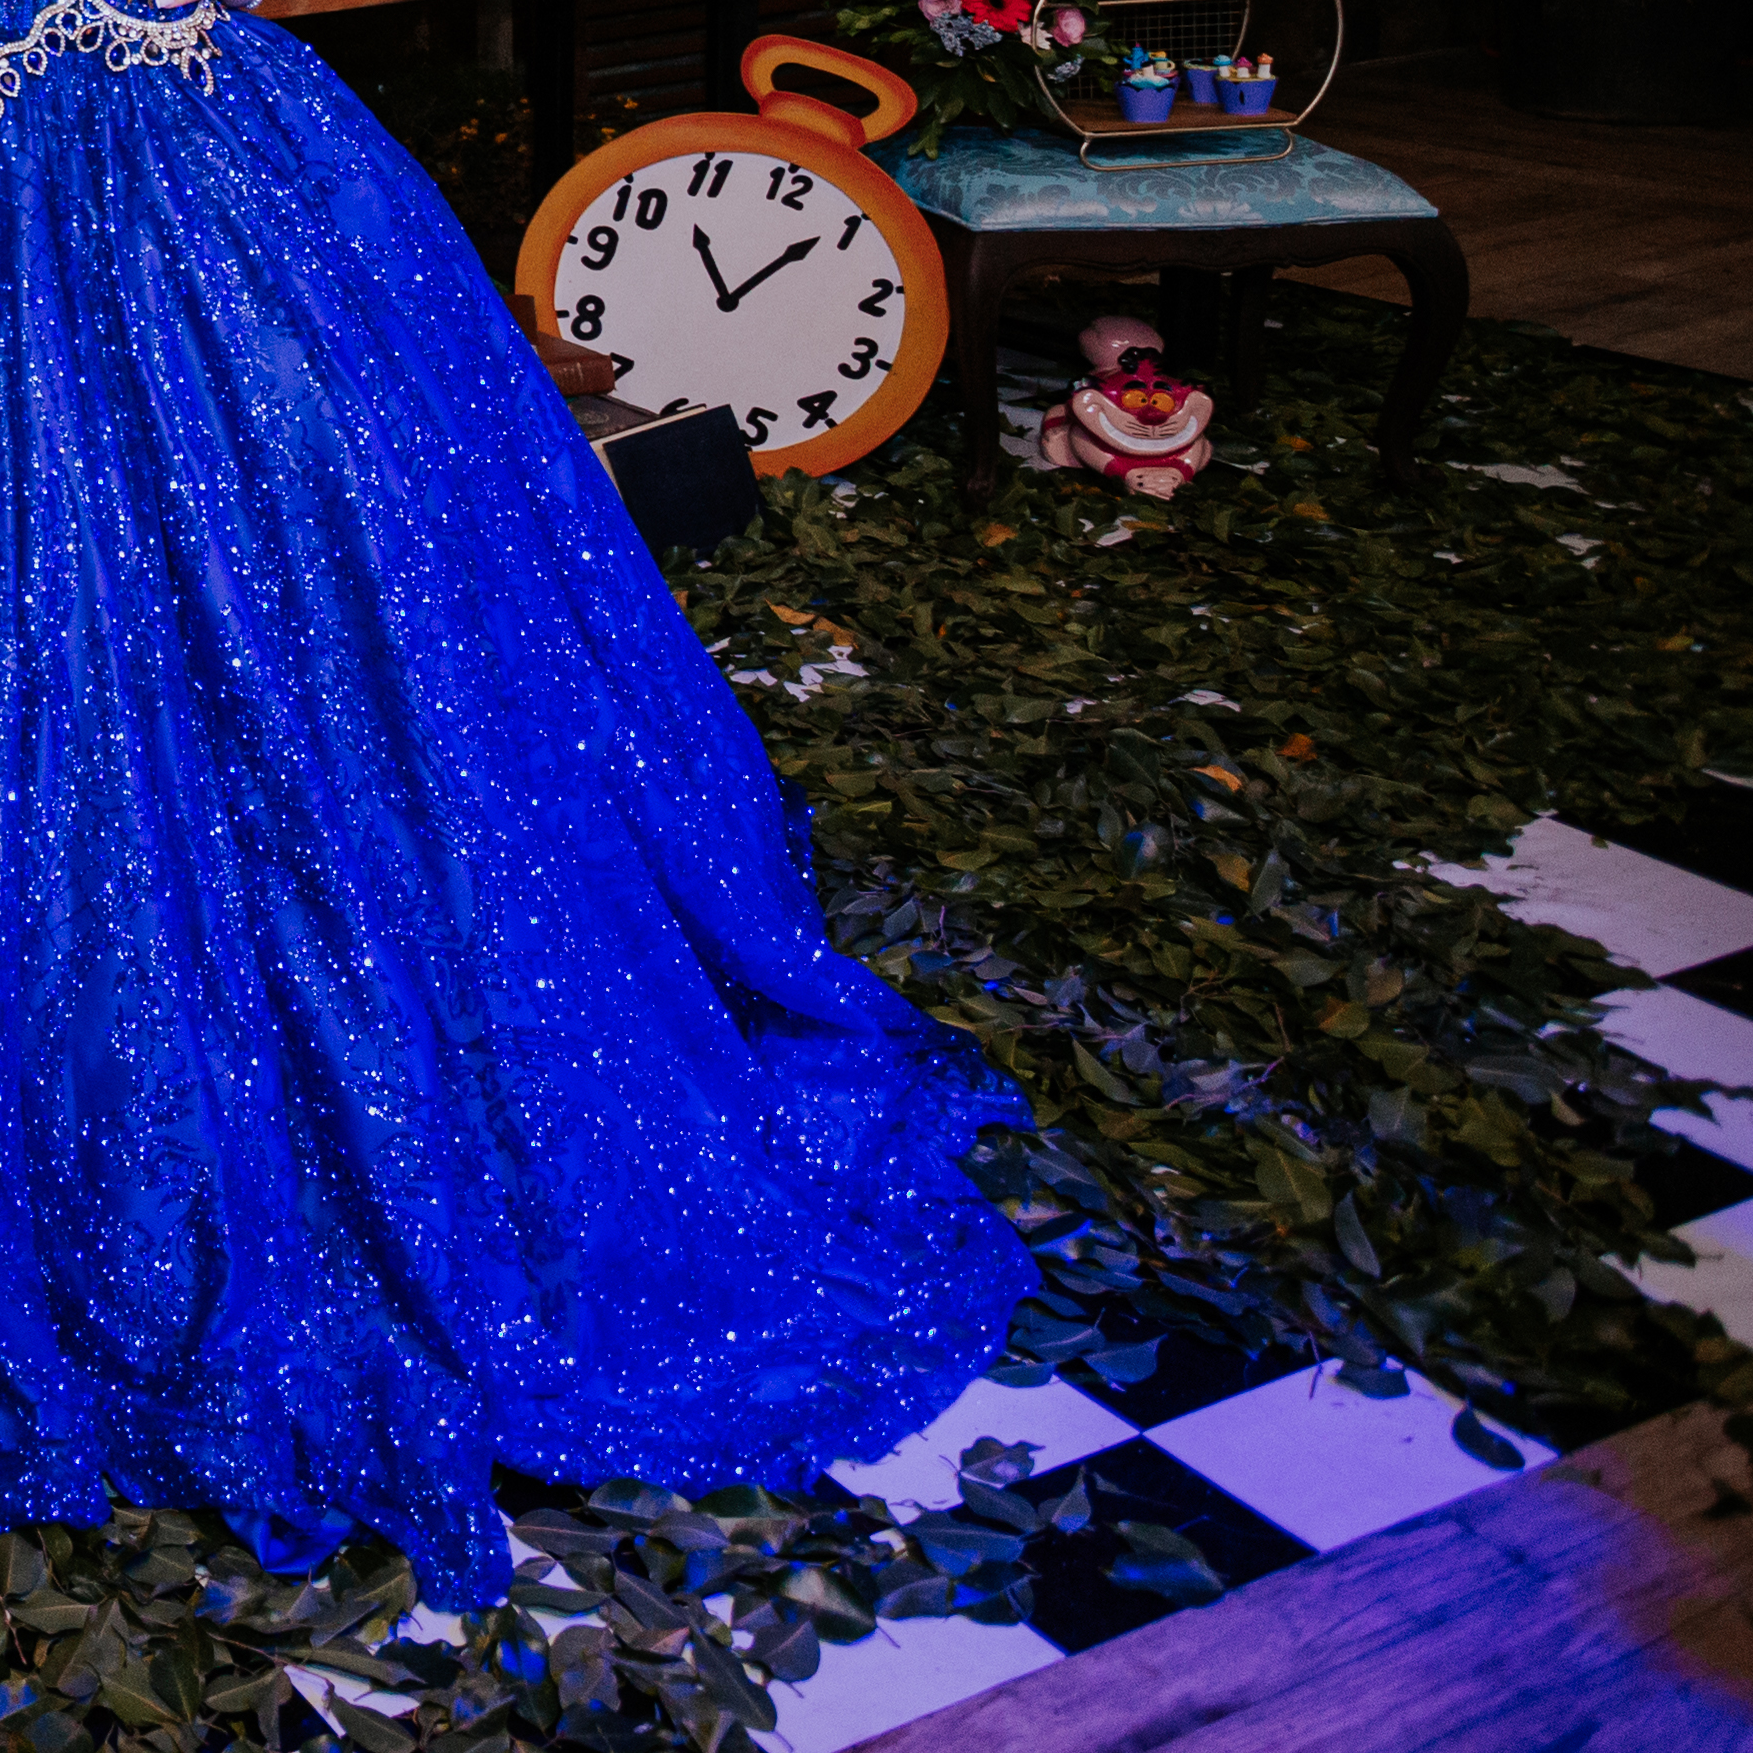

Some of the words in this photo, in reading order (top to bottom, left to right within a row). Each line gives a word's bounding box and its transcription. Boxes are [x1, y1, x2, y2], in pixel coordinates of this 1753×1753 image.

[687, 159, 733, 198] 11
[766, 167, 813, 210] 12
[612, 185, 668, 230] 10
[580, 225, 619, 270] 9
[837, 215, 862, 250] 1
[571, 294, 605, 340] 8
[858, 278, 894, 317] 2
[838, 337, 879, 379] 3
[739, 407, 778, 446] 5
[797, 390, 837, 428] 4
